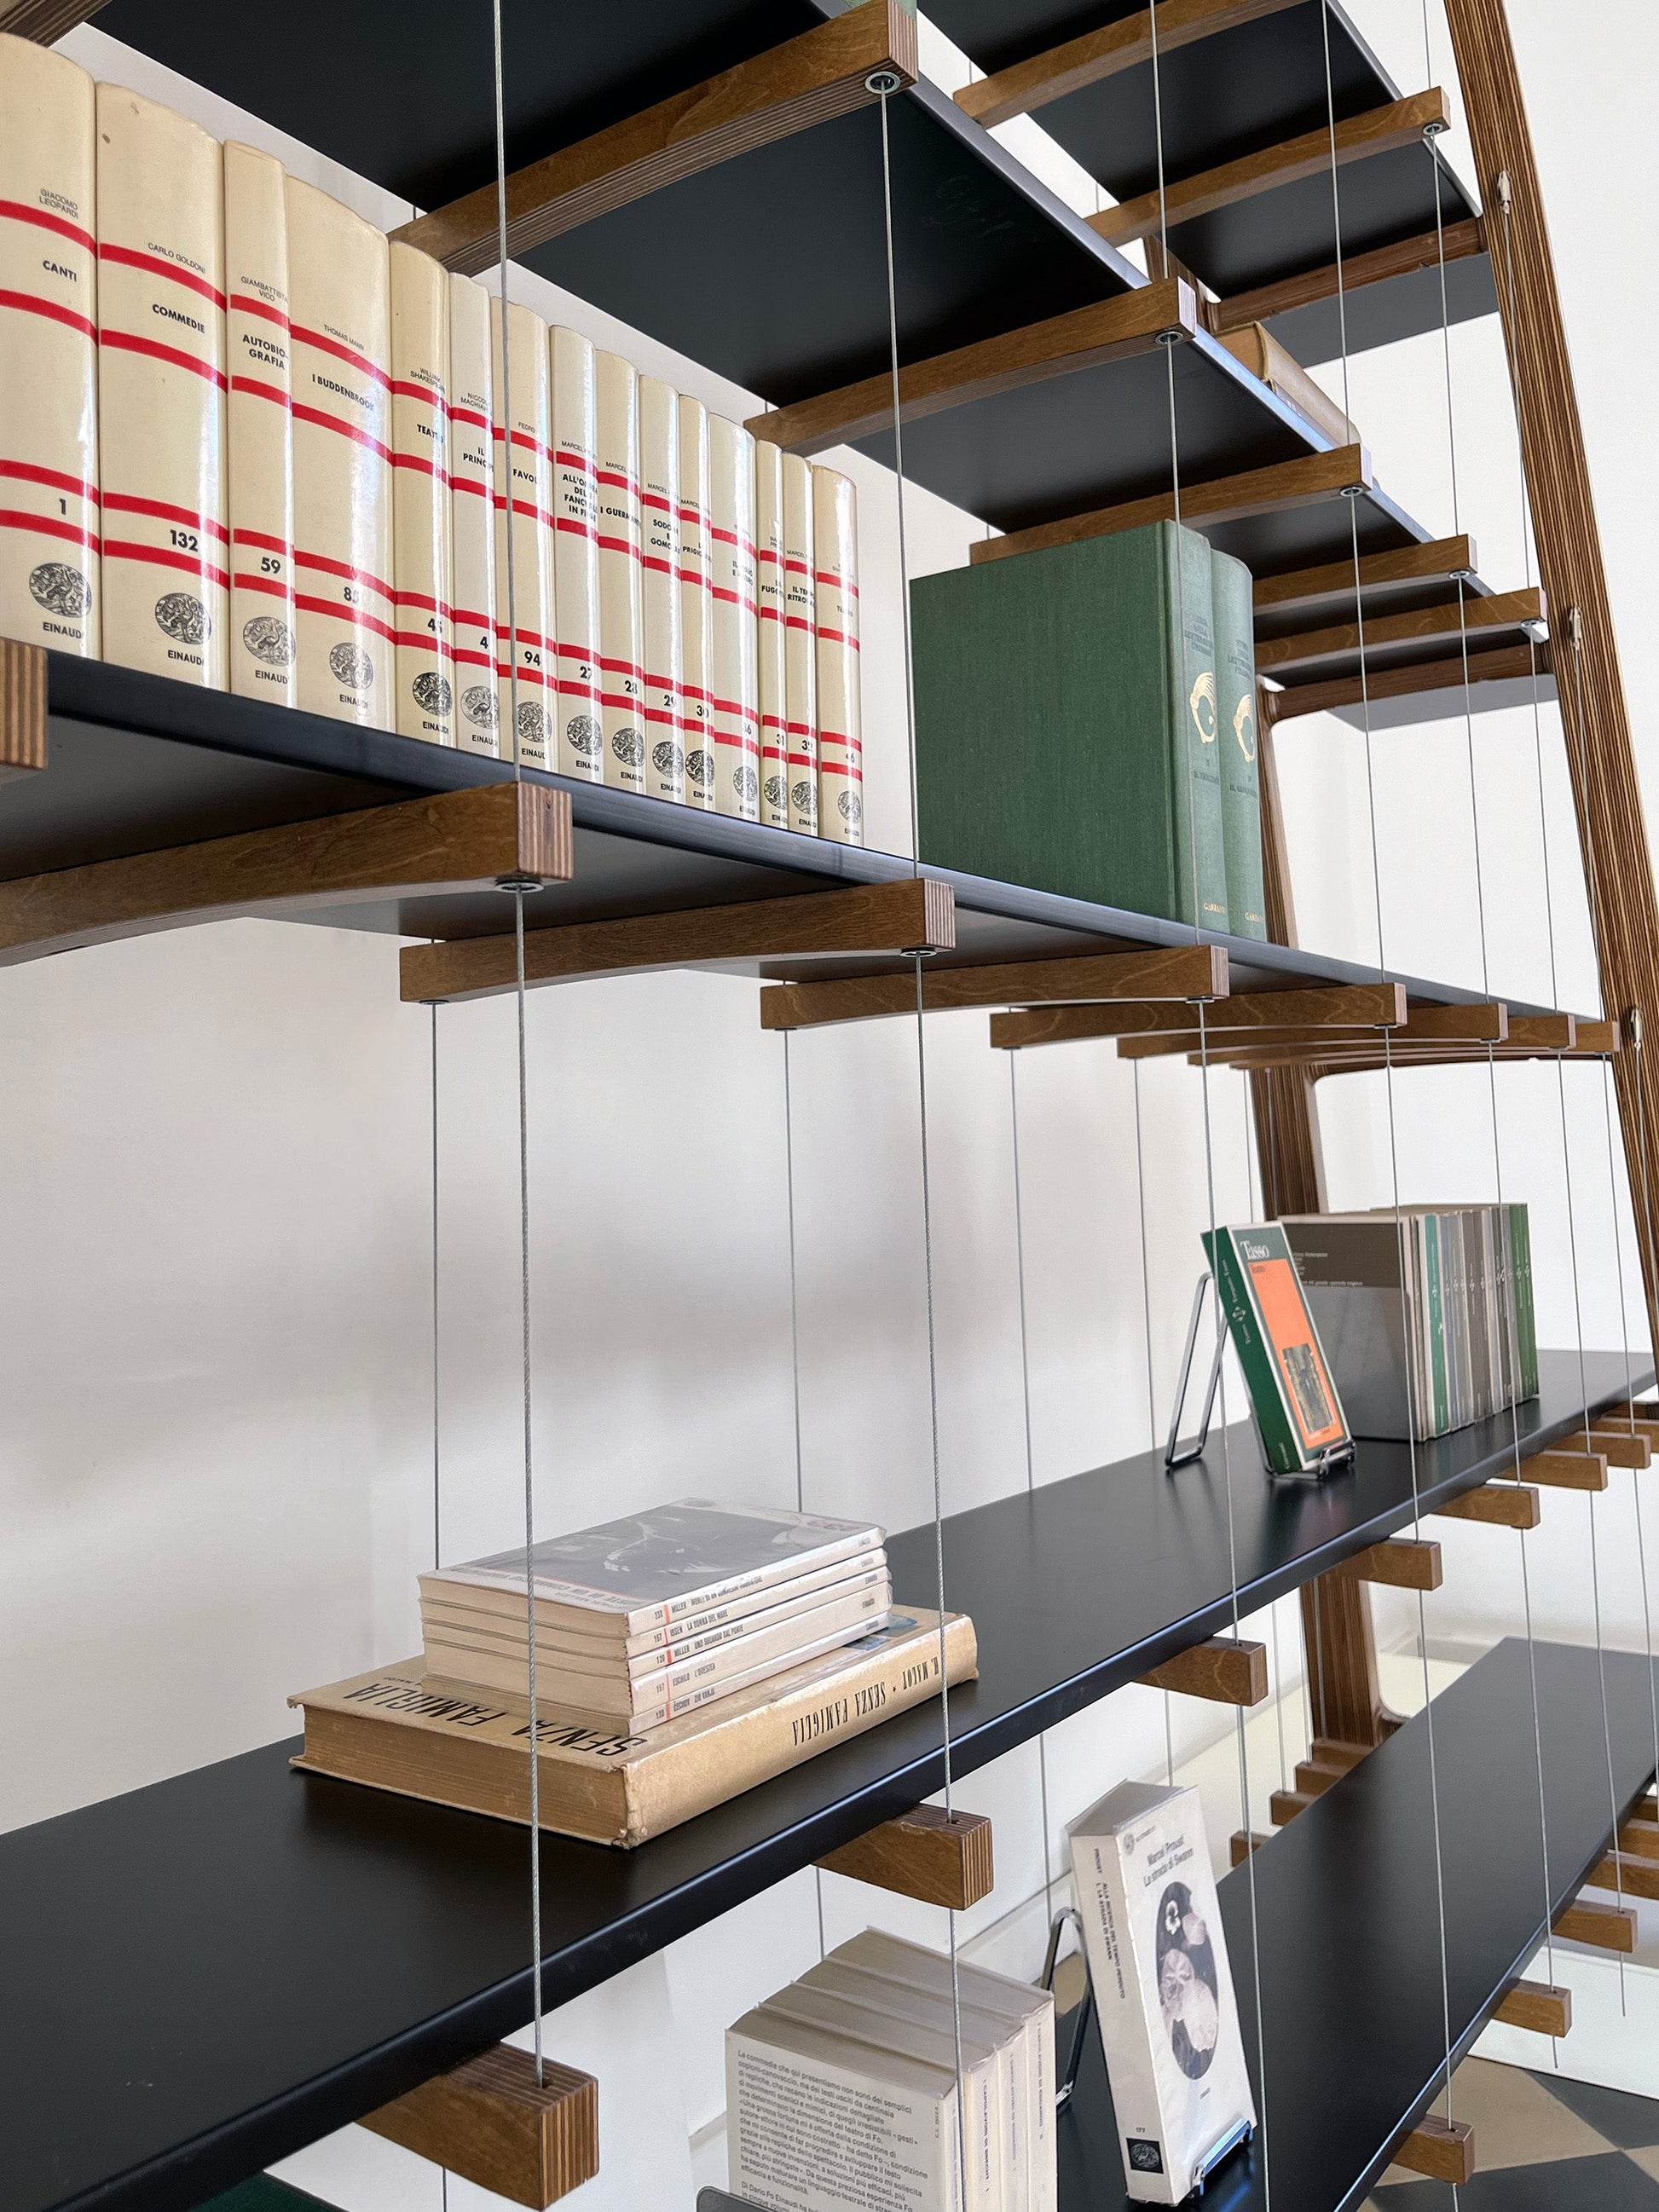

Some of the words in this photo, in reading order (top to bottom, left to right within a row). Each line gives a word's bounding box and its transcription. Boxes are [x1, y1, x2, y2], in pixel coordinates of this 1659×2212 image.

[39, 196, 78, 219] LEOPARDI
[40, 188, 78, 211] GIACOMO
[147, 242, 173, 257] CARLO
[176, 253, 205, 274] GOLDONI
[43, 260, 78, 282] CANTI
[258, 290, 275, 302] VICO
[152, 303, 205, 333] COMMEDIE
[242, 334, 289, 359] AUTOBIO-
[324, 324, 348, 342] THOMAS
[349, 337, 364, 351] MANN
[249, 349, 285, 370] GRAFIA
[312, 373, 315, 383] I
[518, 422, 535, 433] FEDRO
[477, 447, 484, 456] IL
[562, 441, 584, 453] MARCEL
[605, 461, 627, 473] MARCEL
[647, 482, 668, 494] MARCEL
[59, 498, 66, 516] 1
[569, 505, 578, 514] IN
[170, 529, 199, 552] 132
[261, 557, 280, 575] 59
[43, 621, 84, 638] EINAUD
[480, 636, 488, 650] 4
[167, 650, 205, 666] EINAUD
[524, 651, 541, 667] 94
[255, 670, 288, 684] EINAUD
[625, 680, 638, 695] 28
[696, 705, 709, 719] 30
[1240, 1239, 1269, 1260] Tasso
[671, 1602, 687, 1614] MILLER
[670, 1626, 683, 1637] IBSEN
[687, 1622, 692, 1631] LA
[708, 1614, 717, 1622] DEL
[674, 1644, 690, 1657] MILLER
[694, 1640, 703, 1650] UNO
[703, 1632, 722, 1647] SGUARDO
[722, 1630, 731, 1638] DAL
[731, 1625, 744, 1635] PONTE
[673, 1672, 691, 1687] ESCHILO
[902, 1665, 928, 1690] MALOT
[344, 1683, 508, 1727] FAMIGLIA
[854, 1681, 887, 1717] SENZA
[791, 1697, 849, 1746] FAMIGLIA
[511, 1719, 648, 1757] SENZA
[1094, 1848, 1103, 1874] PROUST
[1147, 1847, 1165, 1867] Marcel
[1165, 1834, 1184, 1854] Proust
[1143, 1875, 1152, 1887] La
[1168, 1858, 1174, 1870] di
[1096, 1889, 1103, 1898] LA
[1112, 1944, 1120, 1967] TEMPO
